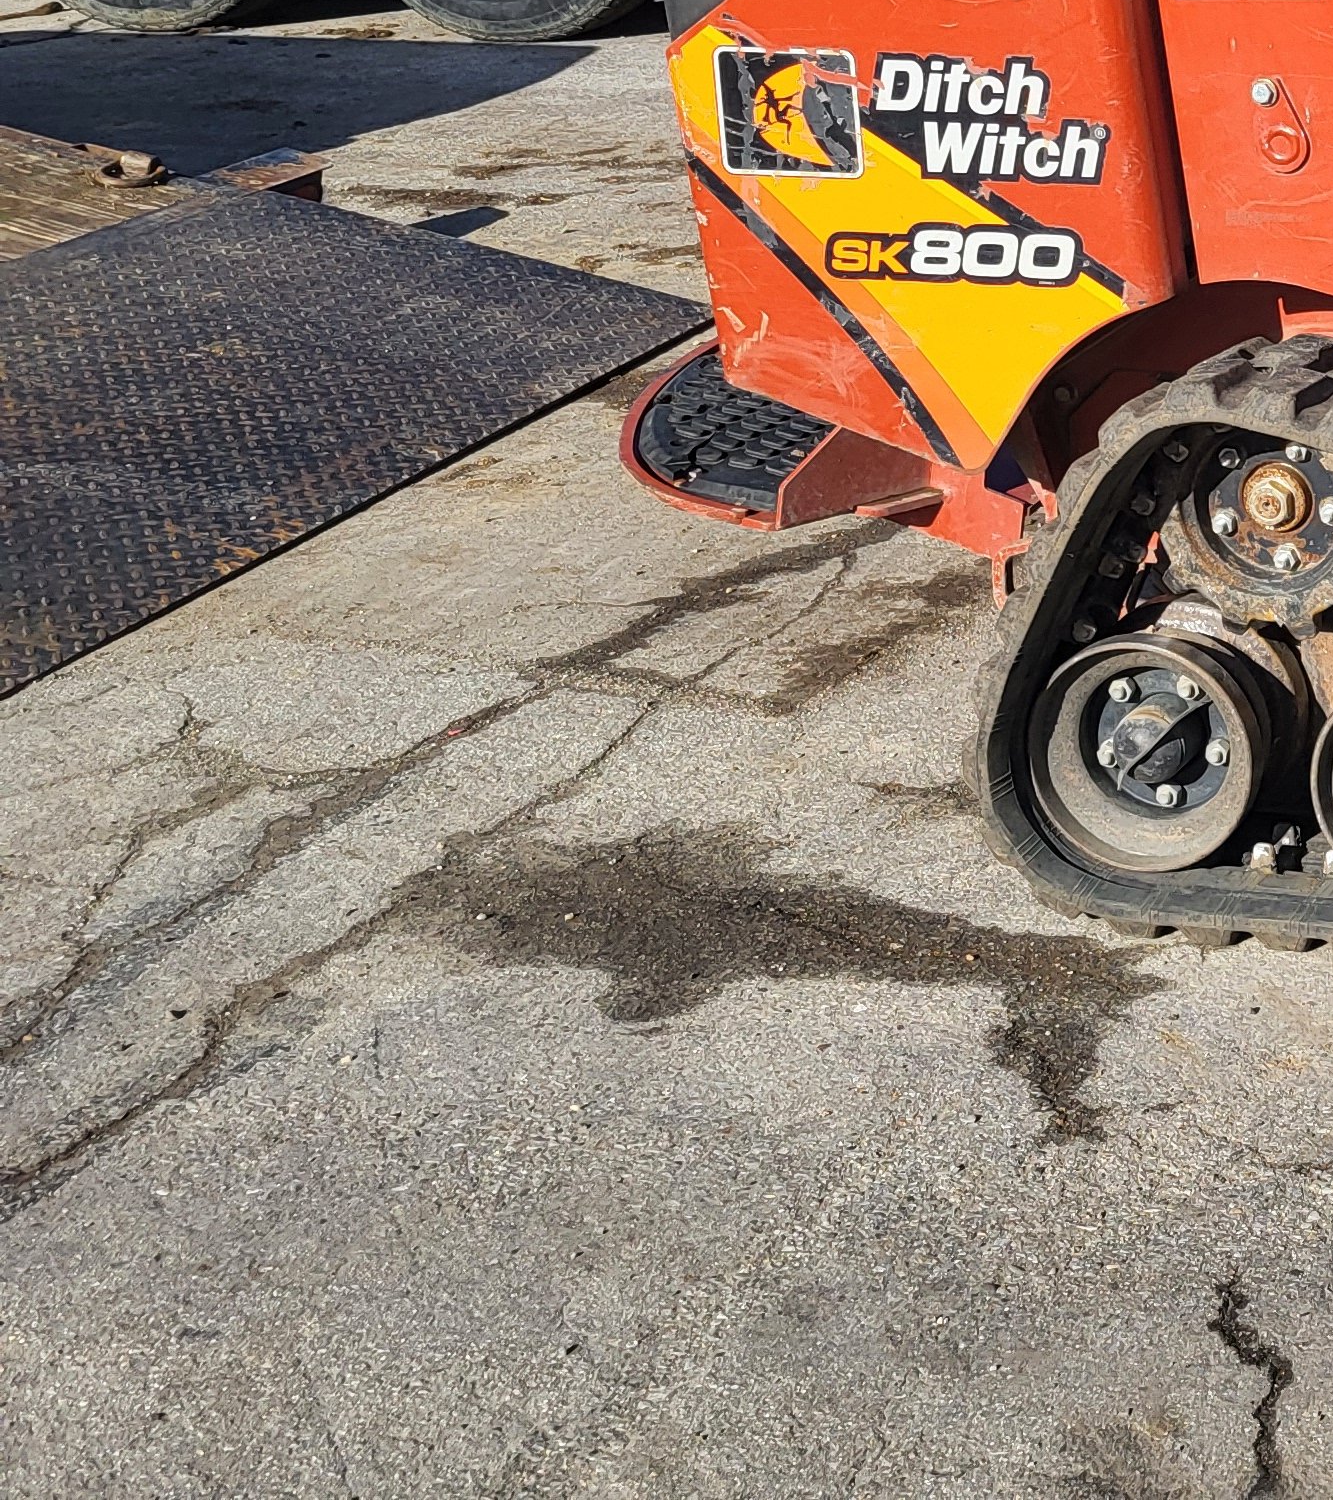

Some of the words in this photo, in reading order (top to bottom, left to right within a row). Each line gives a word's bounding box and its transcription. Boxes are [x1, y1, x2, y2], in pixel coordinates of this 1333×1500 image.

[875, 59, 1048, 117] Ditch
[922, 120, 1102, 180] Witch
[831, 229, 1077, 281] SK800
